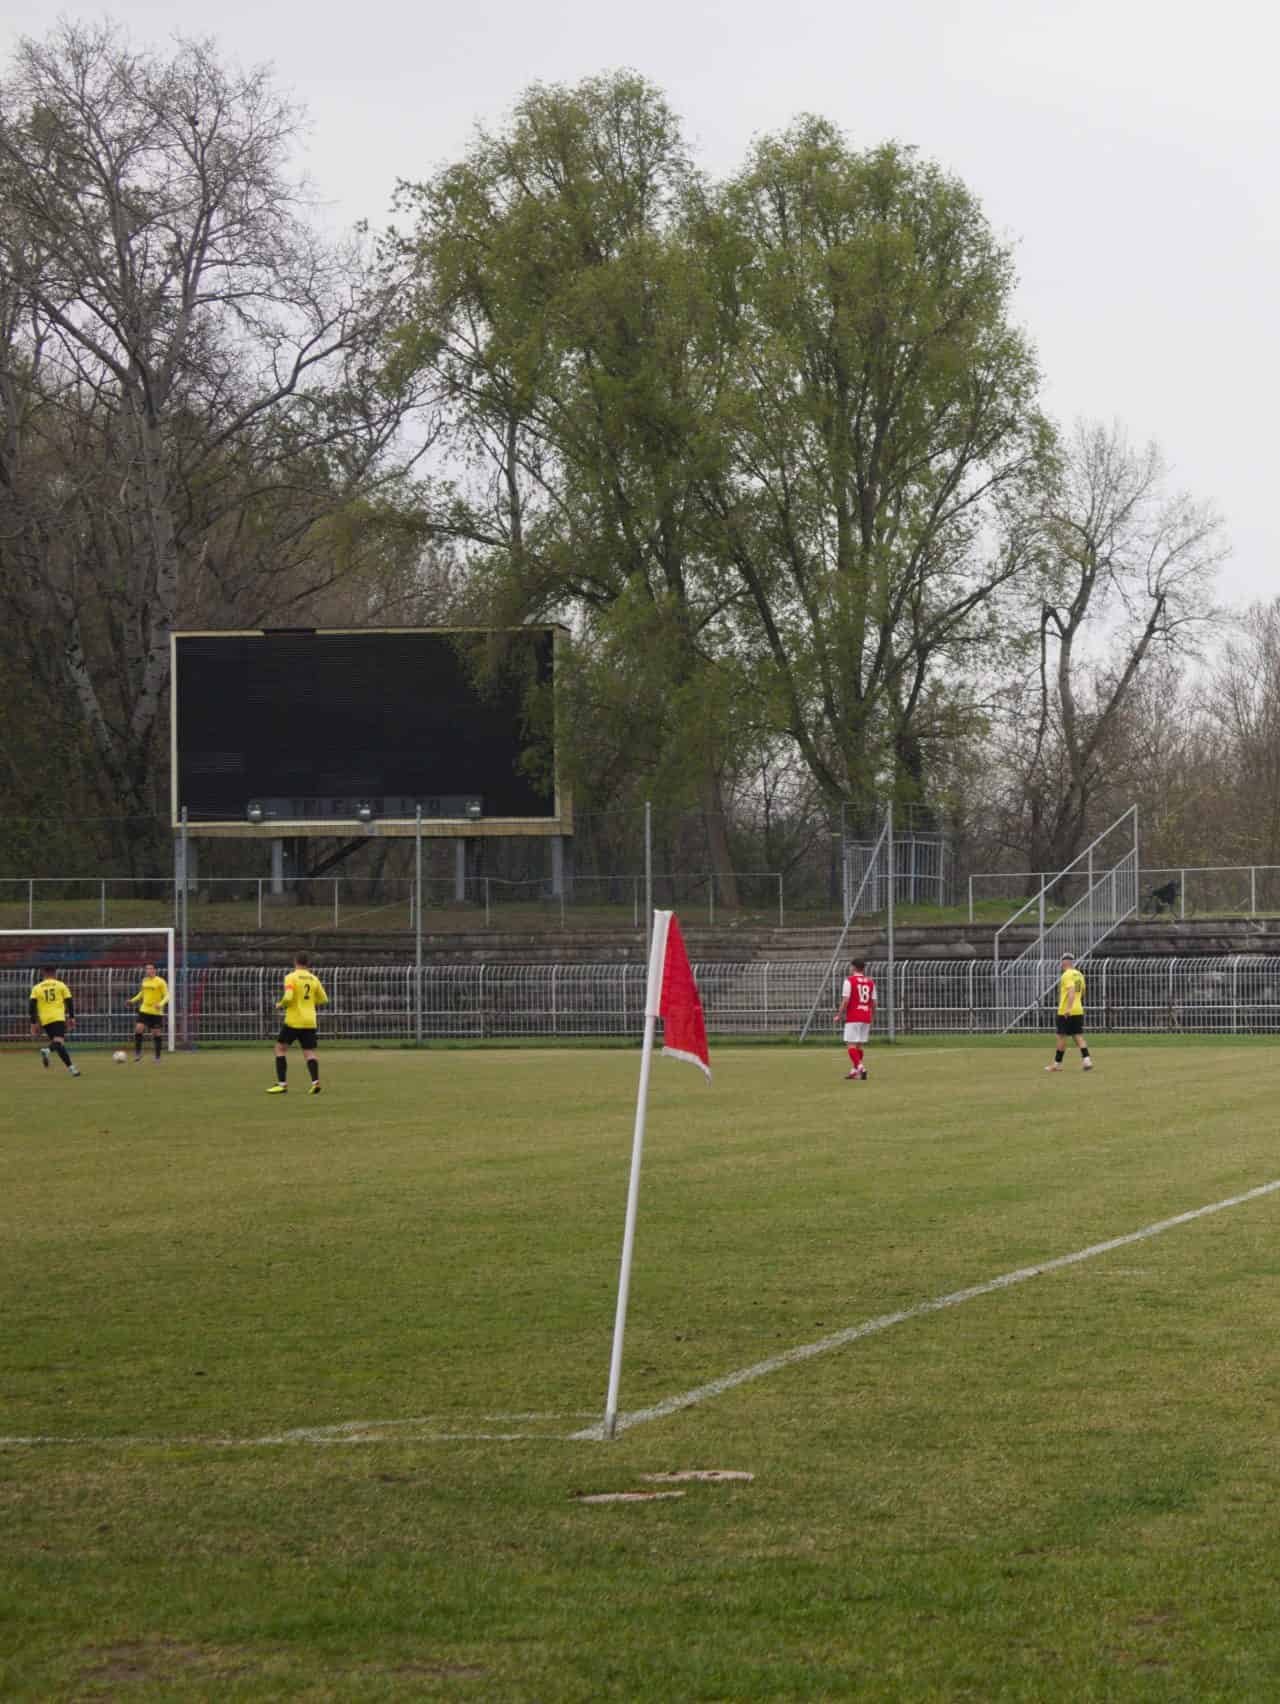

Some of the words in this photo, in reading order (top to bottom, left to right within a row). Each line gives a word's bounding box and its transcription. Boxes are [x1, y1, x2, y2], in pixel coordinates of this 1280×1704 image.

[43, 988, 56, 1002] 15
[303, 983, 311, 1000] 2
[857, 983, 870, 1004] 18
